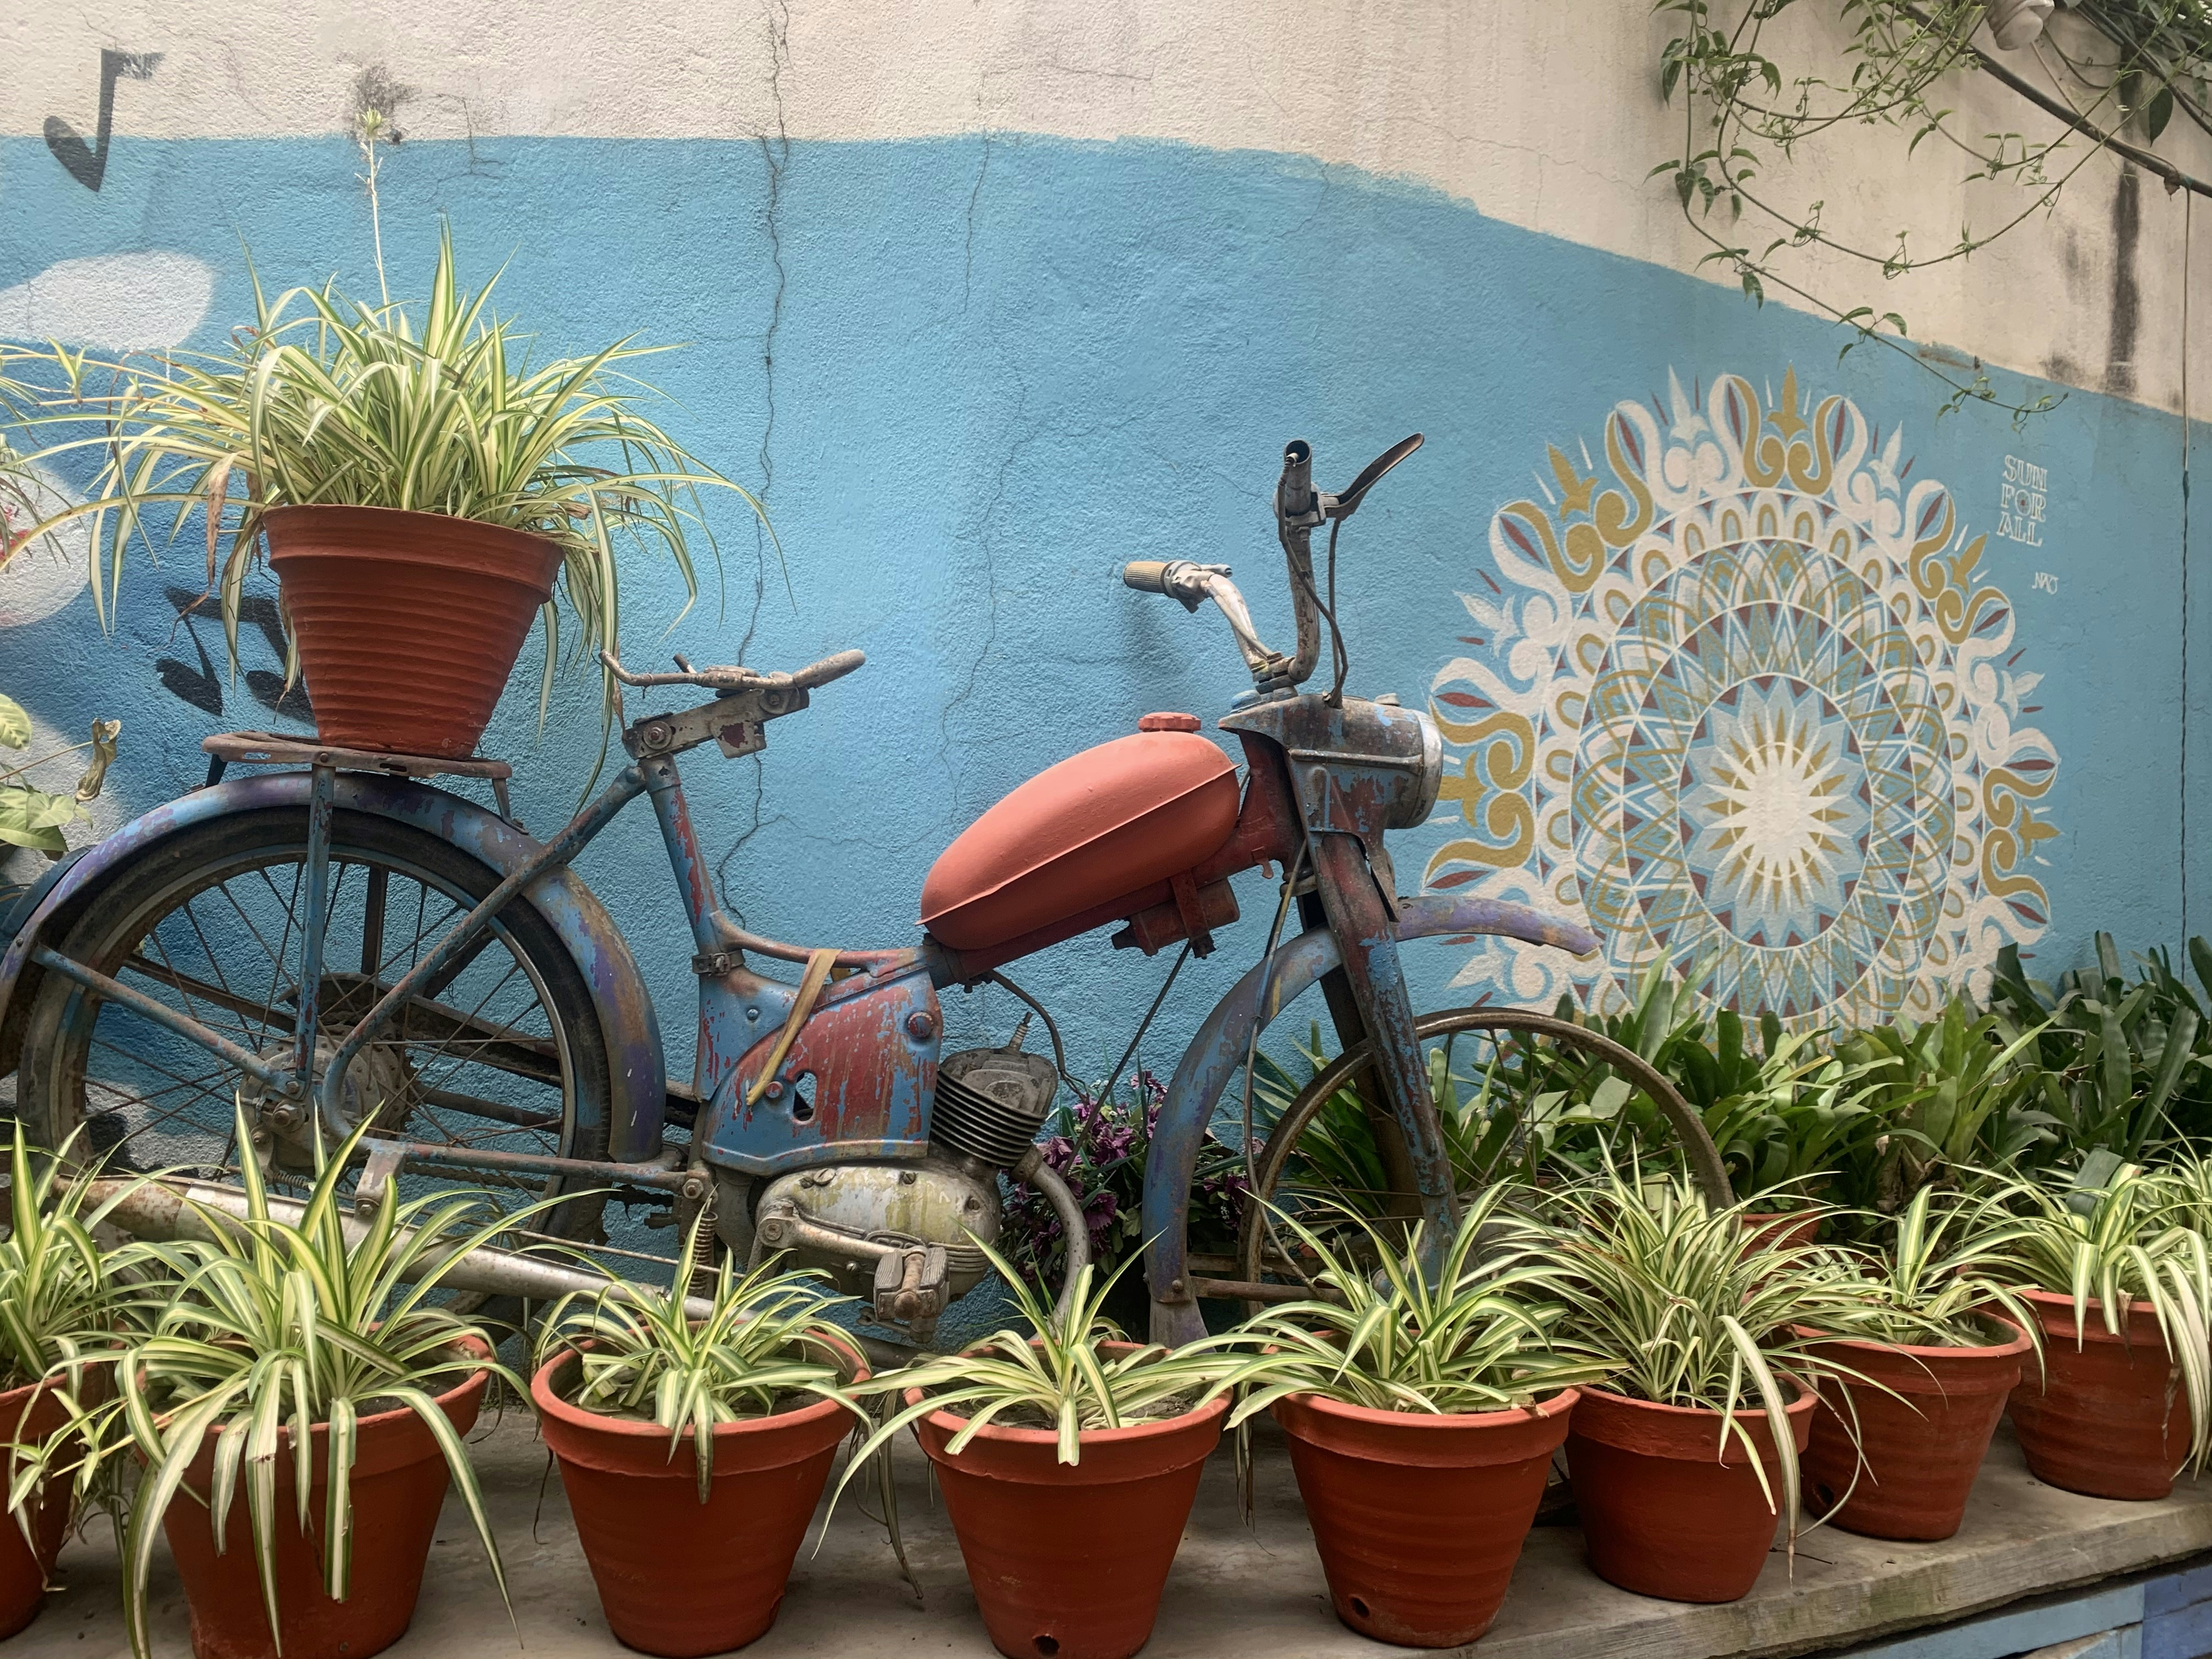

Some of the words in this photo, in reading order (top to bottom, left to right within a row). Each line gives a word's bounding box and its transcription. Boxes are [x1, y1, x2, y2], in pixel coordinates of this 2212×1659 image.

[2003, 454, 2047, 492] SUN
[2001, 483, 2046, 522] FOR
[1997, 511, 2042, 547] ALL
